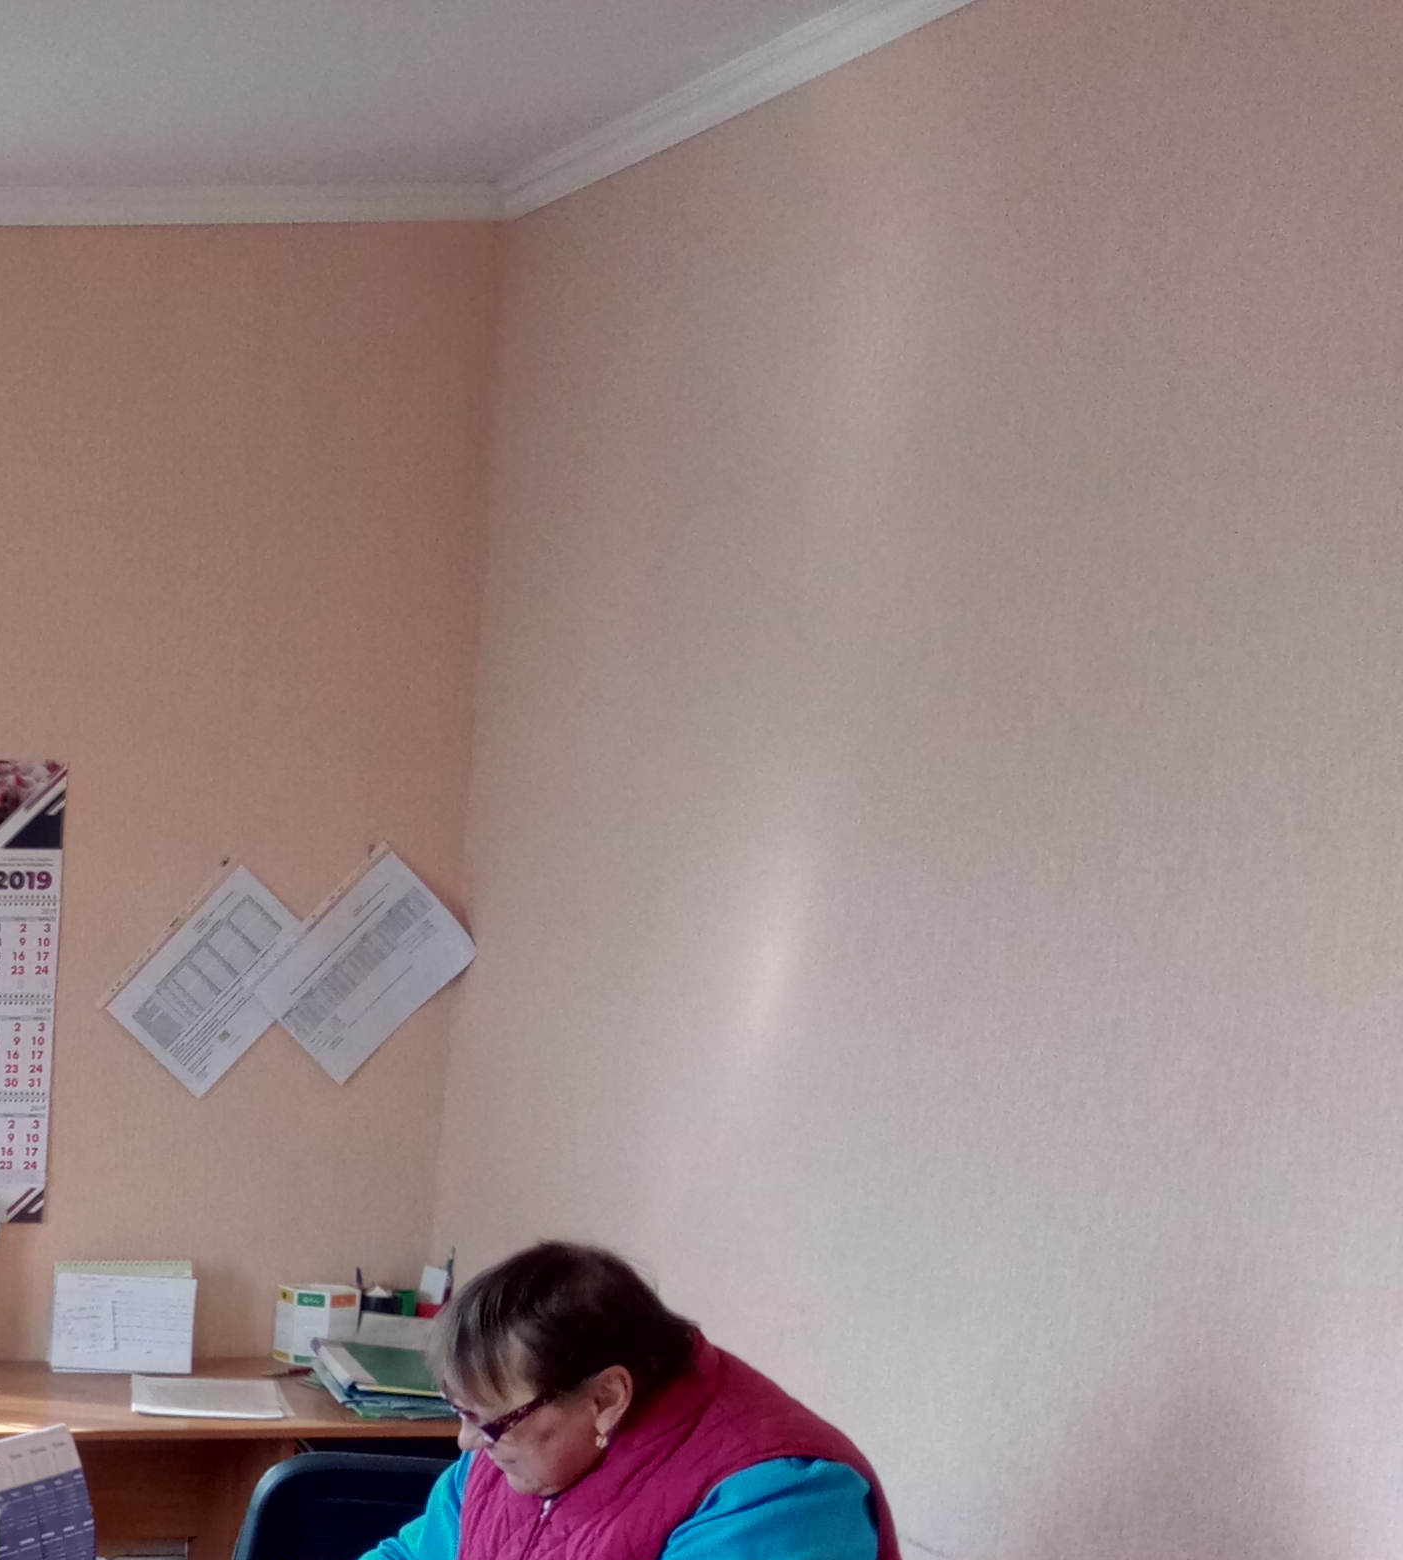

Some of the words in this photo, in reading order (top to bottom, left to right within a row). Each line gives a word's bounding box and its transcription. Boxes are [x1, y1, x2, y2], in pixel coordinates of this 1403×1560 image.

[37, 937, 51, 947] 10
[12, 951, 26, 961] 16
[36, 951, 50, 961] 17
[10, 965, 26, 975] 23
[34, 965, 49, 975] 24
[31, 1036, 46, 1046] 10
[6, 1049, 20, 1059] 16
[31, 1049, 44, 1059] 17
[4, 1063, 19, 1073] 23
[29, 1064, 44, 1073] 24
[3, 1077, 19, 1087] 30
[28, 1077, 42, 1087] 31
[26, 1133, 40, 1142] 10
[0, 1146, 14, 1156] 16
[25, 1146, 39, 1156] 17
[23, 1160, 38, 1170] 24
